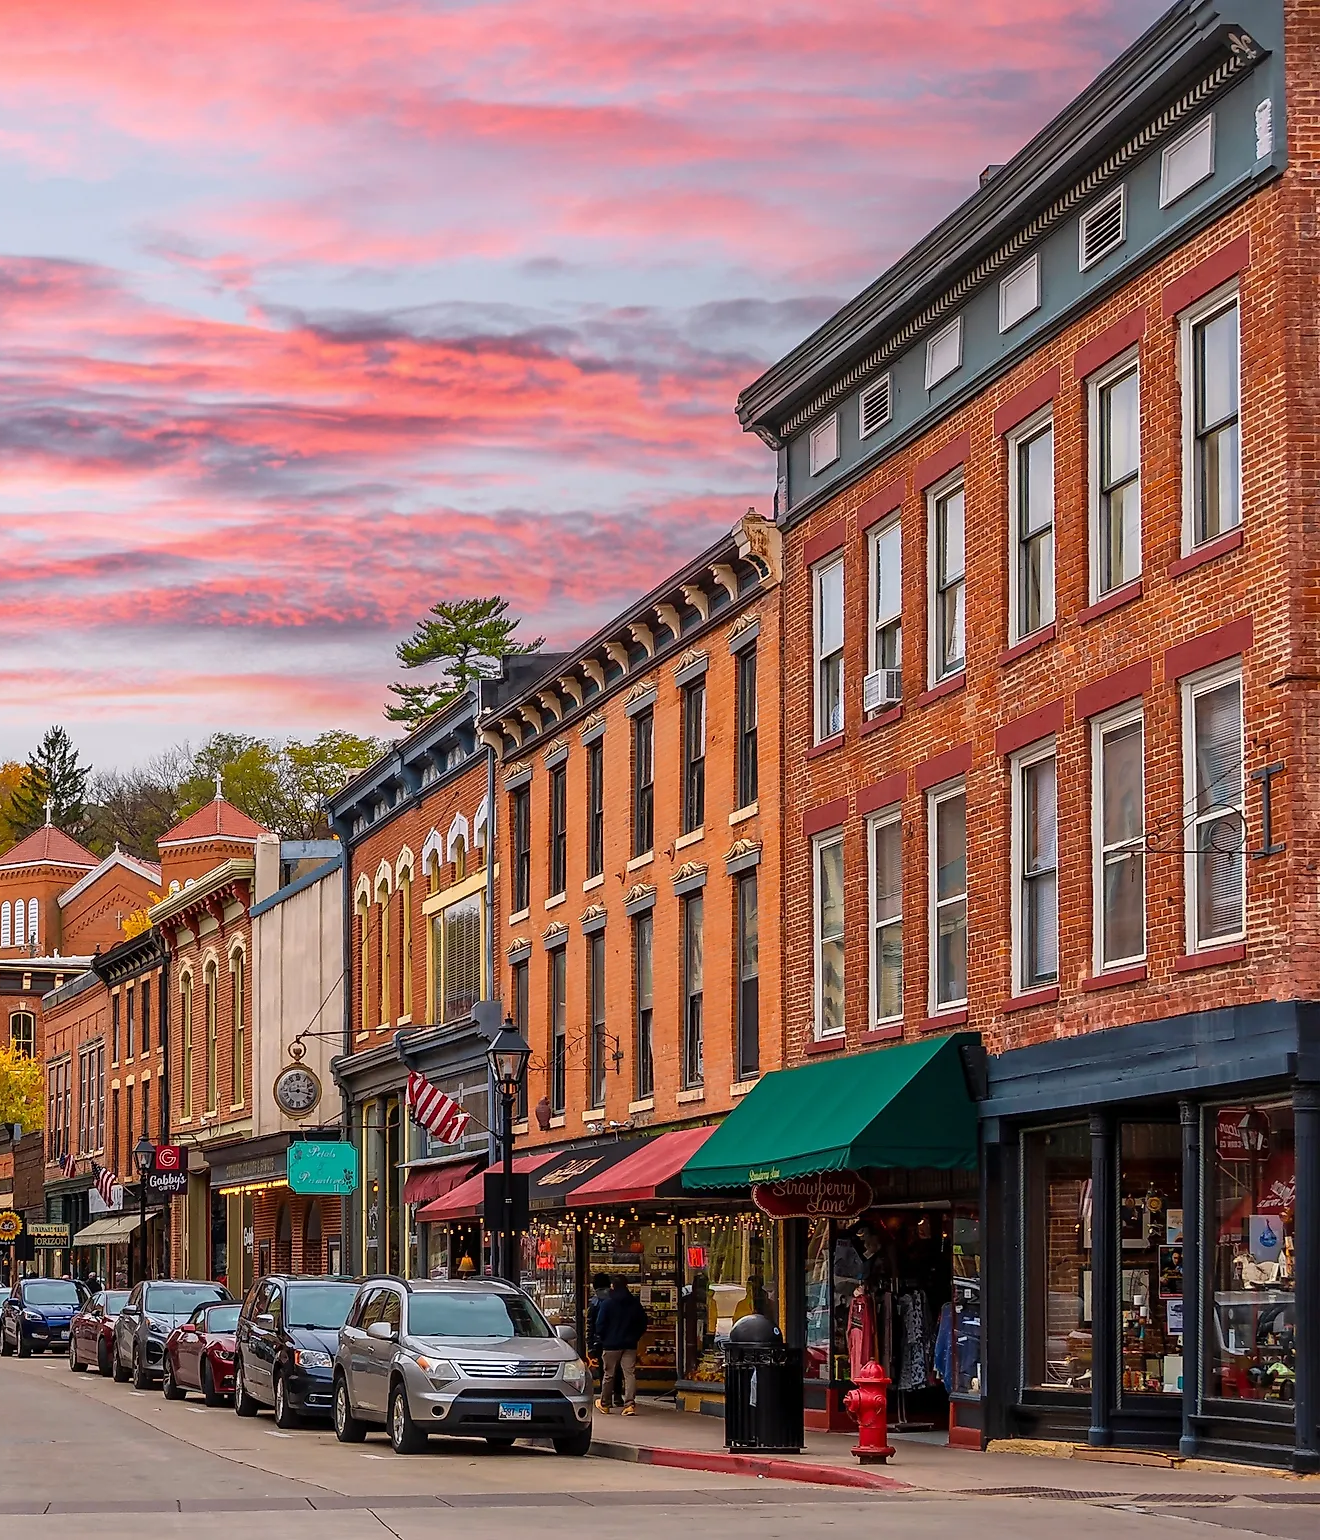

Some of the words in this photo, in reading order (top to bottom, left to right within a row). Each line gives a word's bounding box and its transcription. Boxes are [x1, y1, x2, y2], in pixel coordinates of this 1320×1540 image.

[149, 1172, 187, 1192] Gabby's
[772, 1176, 856, 1205] Strawberry
[806, 1194, 847, 1213] Lane
